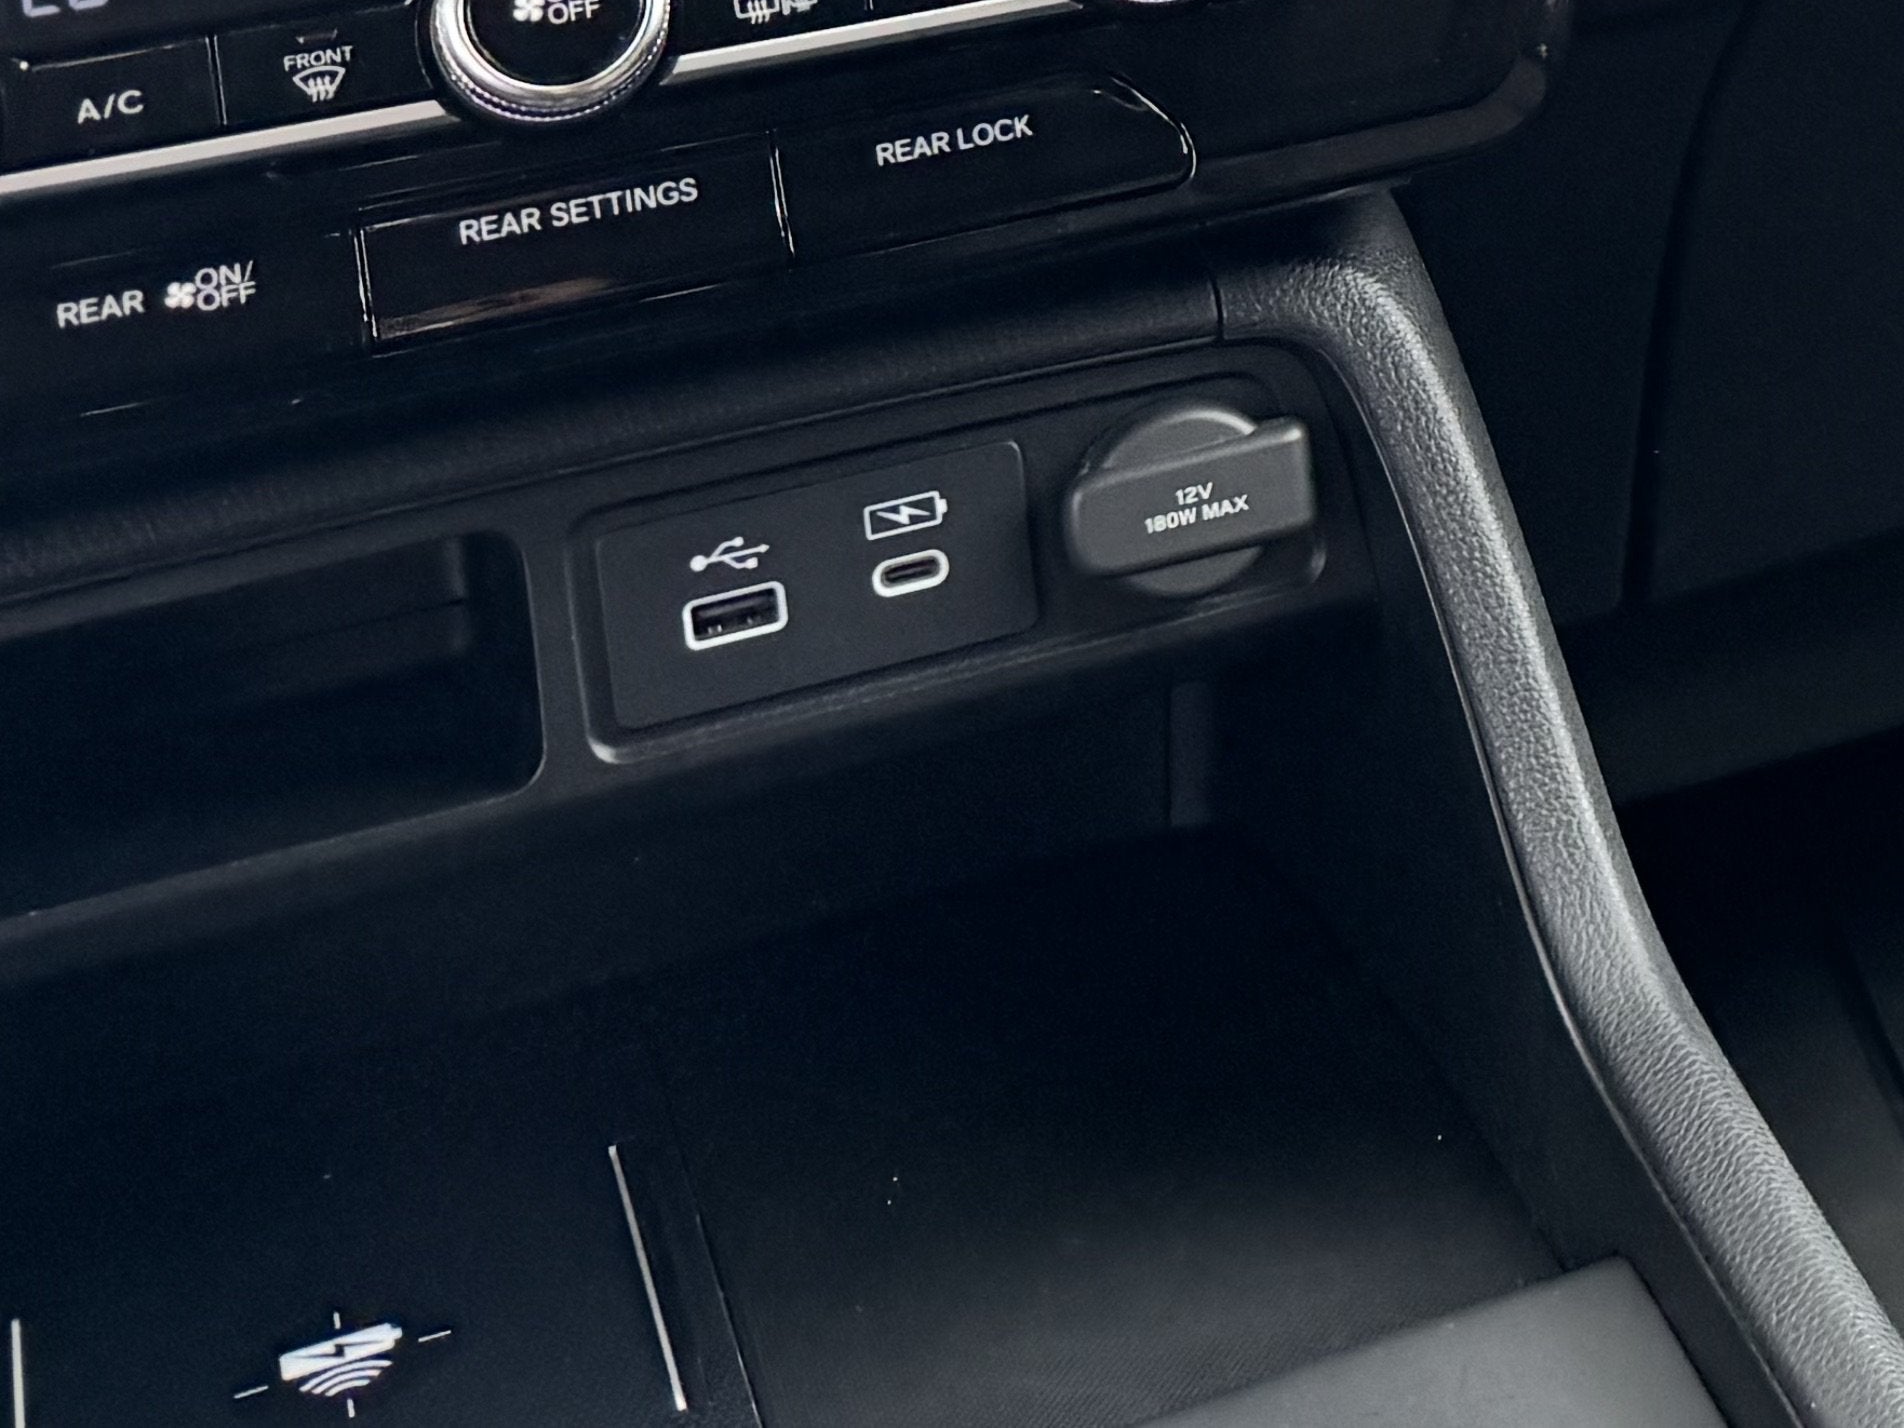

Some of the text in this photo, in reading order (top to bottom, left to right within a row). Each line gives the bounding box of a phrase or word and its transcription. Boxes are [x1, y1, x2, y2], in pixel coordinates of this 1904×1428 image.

[283, 45, 353, 73] FRONT
[77, 90, 144, 125] A/C
[875, 113, 1034, 167] REAR LOCK
[458, 176, 699, 245] REAR SETTINGS
[56, 289, 145, 329] REAR
[197, 282, 257, 312] OFF
[1175, 481, 1213, 506] 12V
[1144, 494, 1249, 534] 180W MAX
